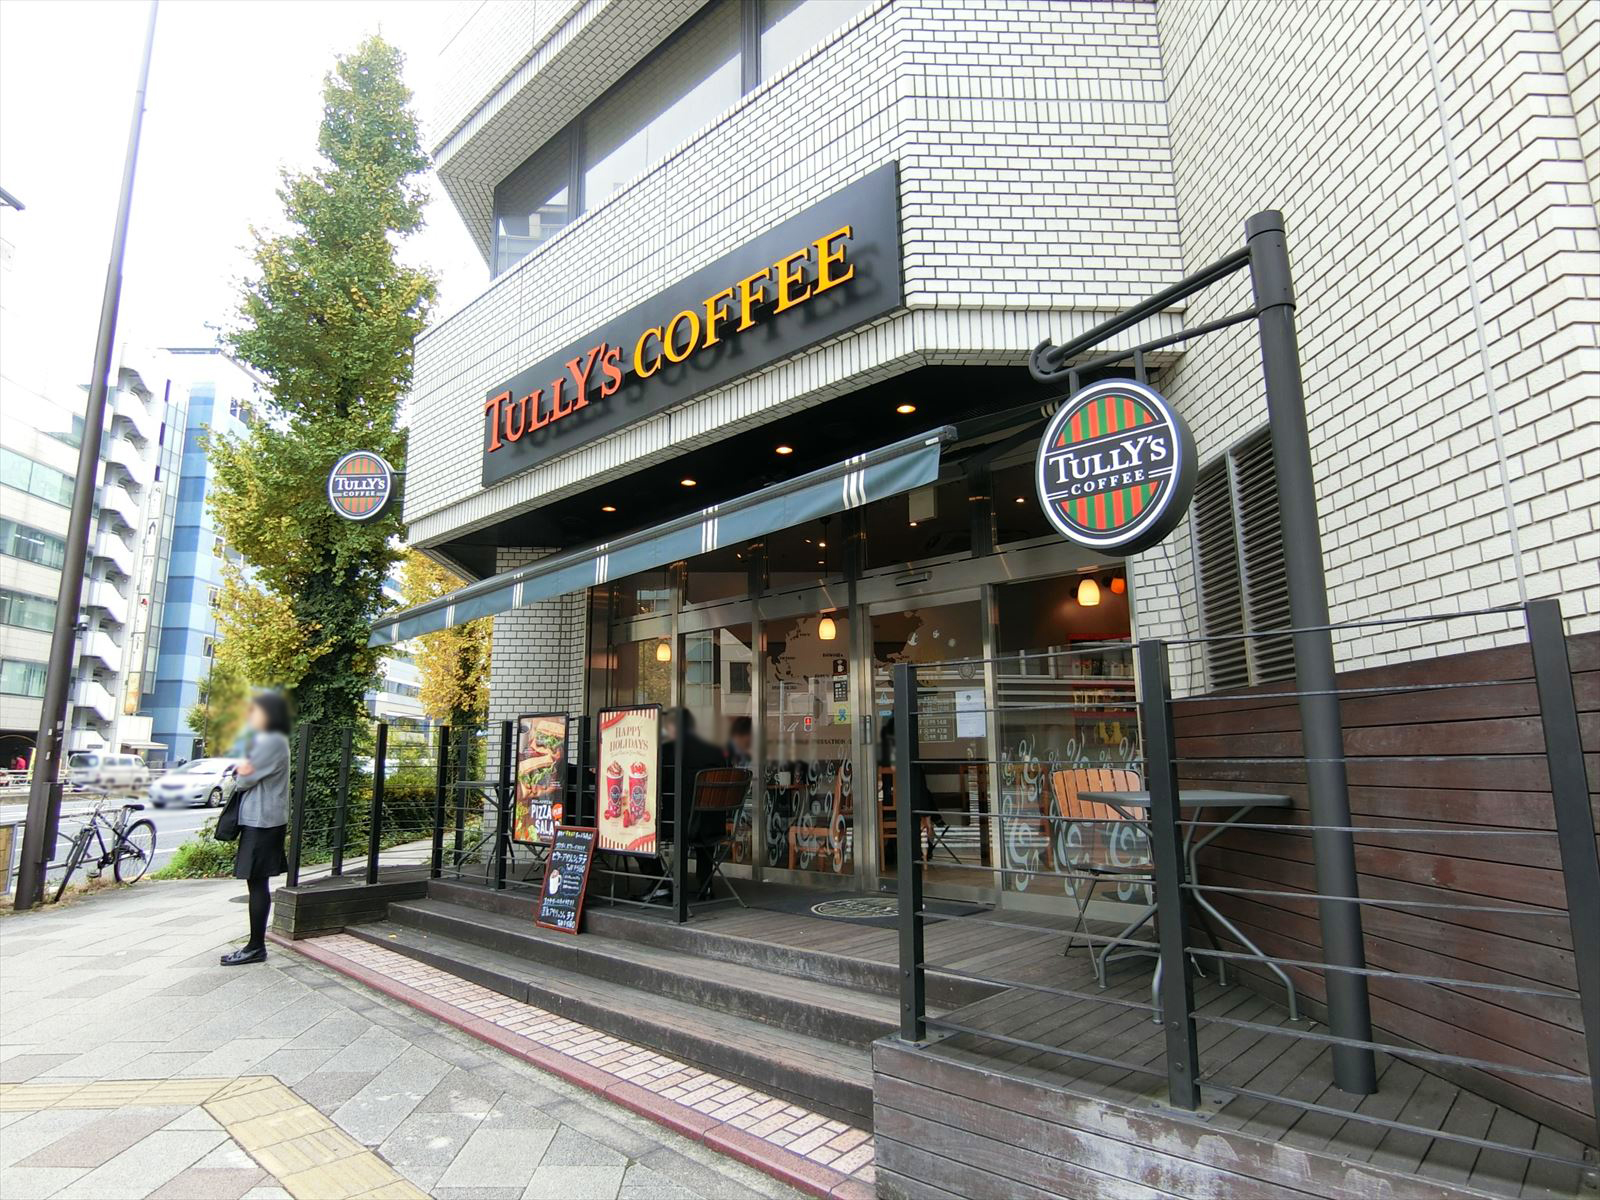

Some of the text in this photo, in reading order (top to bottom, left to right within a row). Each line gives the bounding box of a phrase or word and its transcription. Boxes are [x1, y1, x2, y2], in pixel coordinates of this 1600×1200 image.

[484, 225, 856, 453] TULLY'S COFFEE
[1048, 434, 1167, 484] TULLY'S
[335, 477, 386, 490] TULLY'S
[1070, 469, 1145, 495] COFFEE
[615, 725, 641, 738] HAPPY
[610, 738, 649, 752] HOLIDAYS
[531, 803, 552, 820] PIZZA
